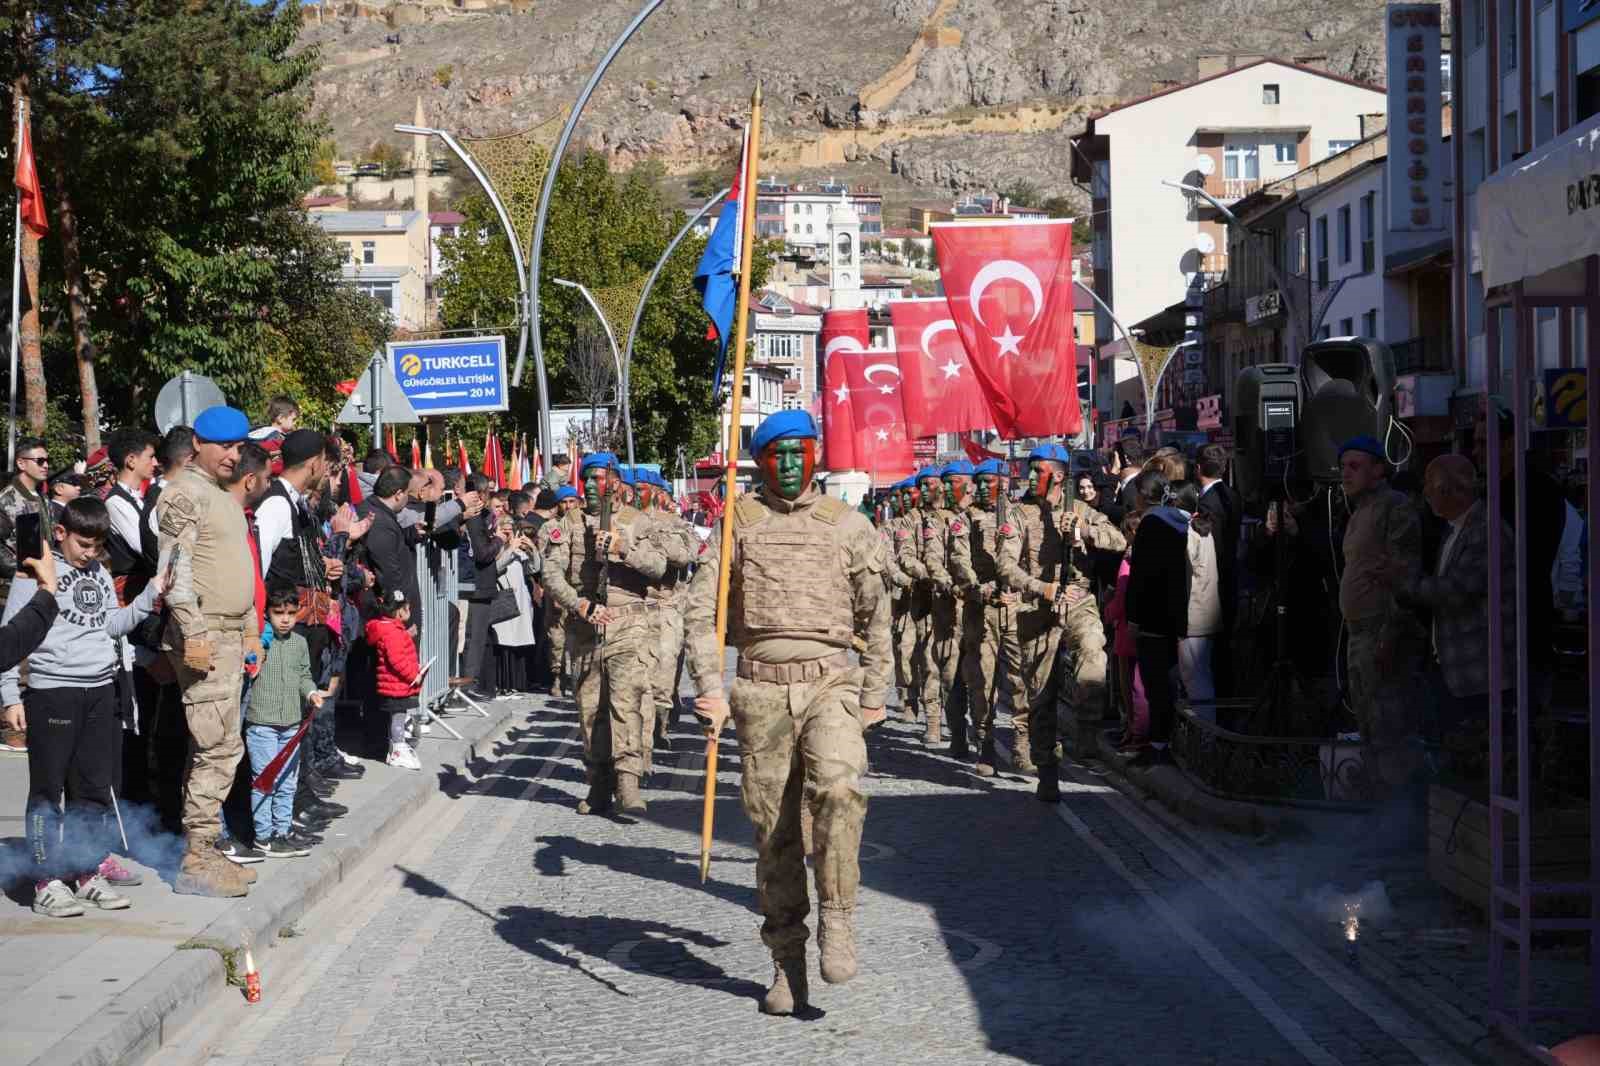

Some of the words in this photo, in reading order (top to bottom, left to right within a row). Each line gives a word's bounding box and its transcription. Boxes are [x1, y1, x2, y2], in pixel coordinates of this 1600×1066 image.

[422, 354, 495, 370] TURKCELL
[403, 376, 457, 388] GÜNGÖRLER
[457, 373, 494, 385] İLETİŞİM
[470, 389, 483, 398] 20
[485, 387, 496, 397] M
[61, 608, 85, 627] ALL
